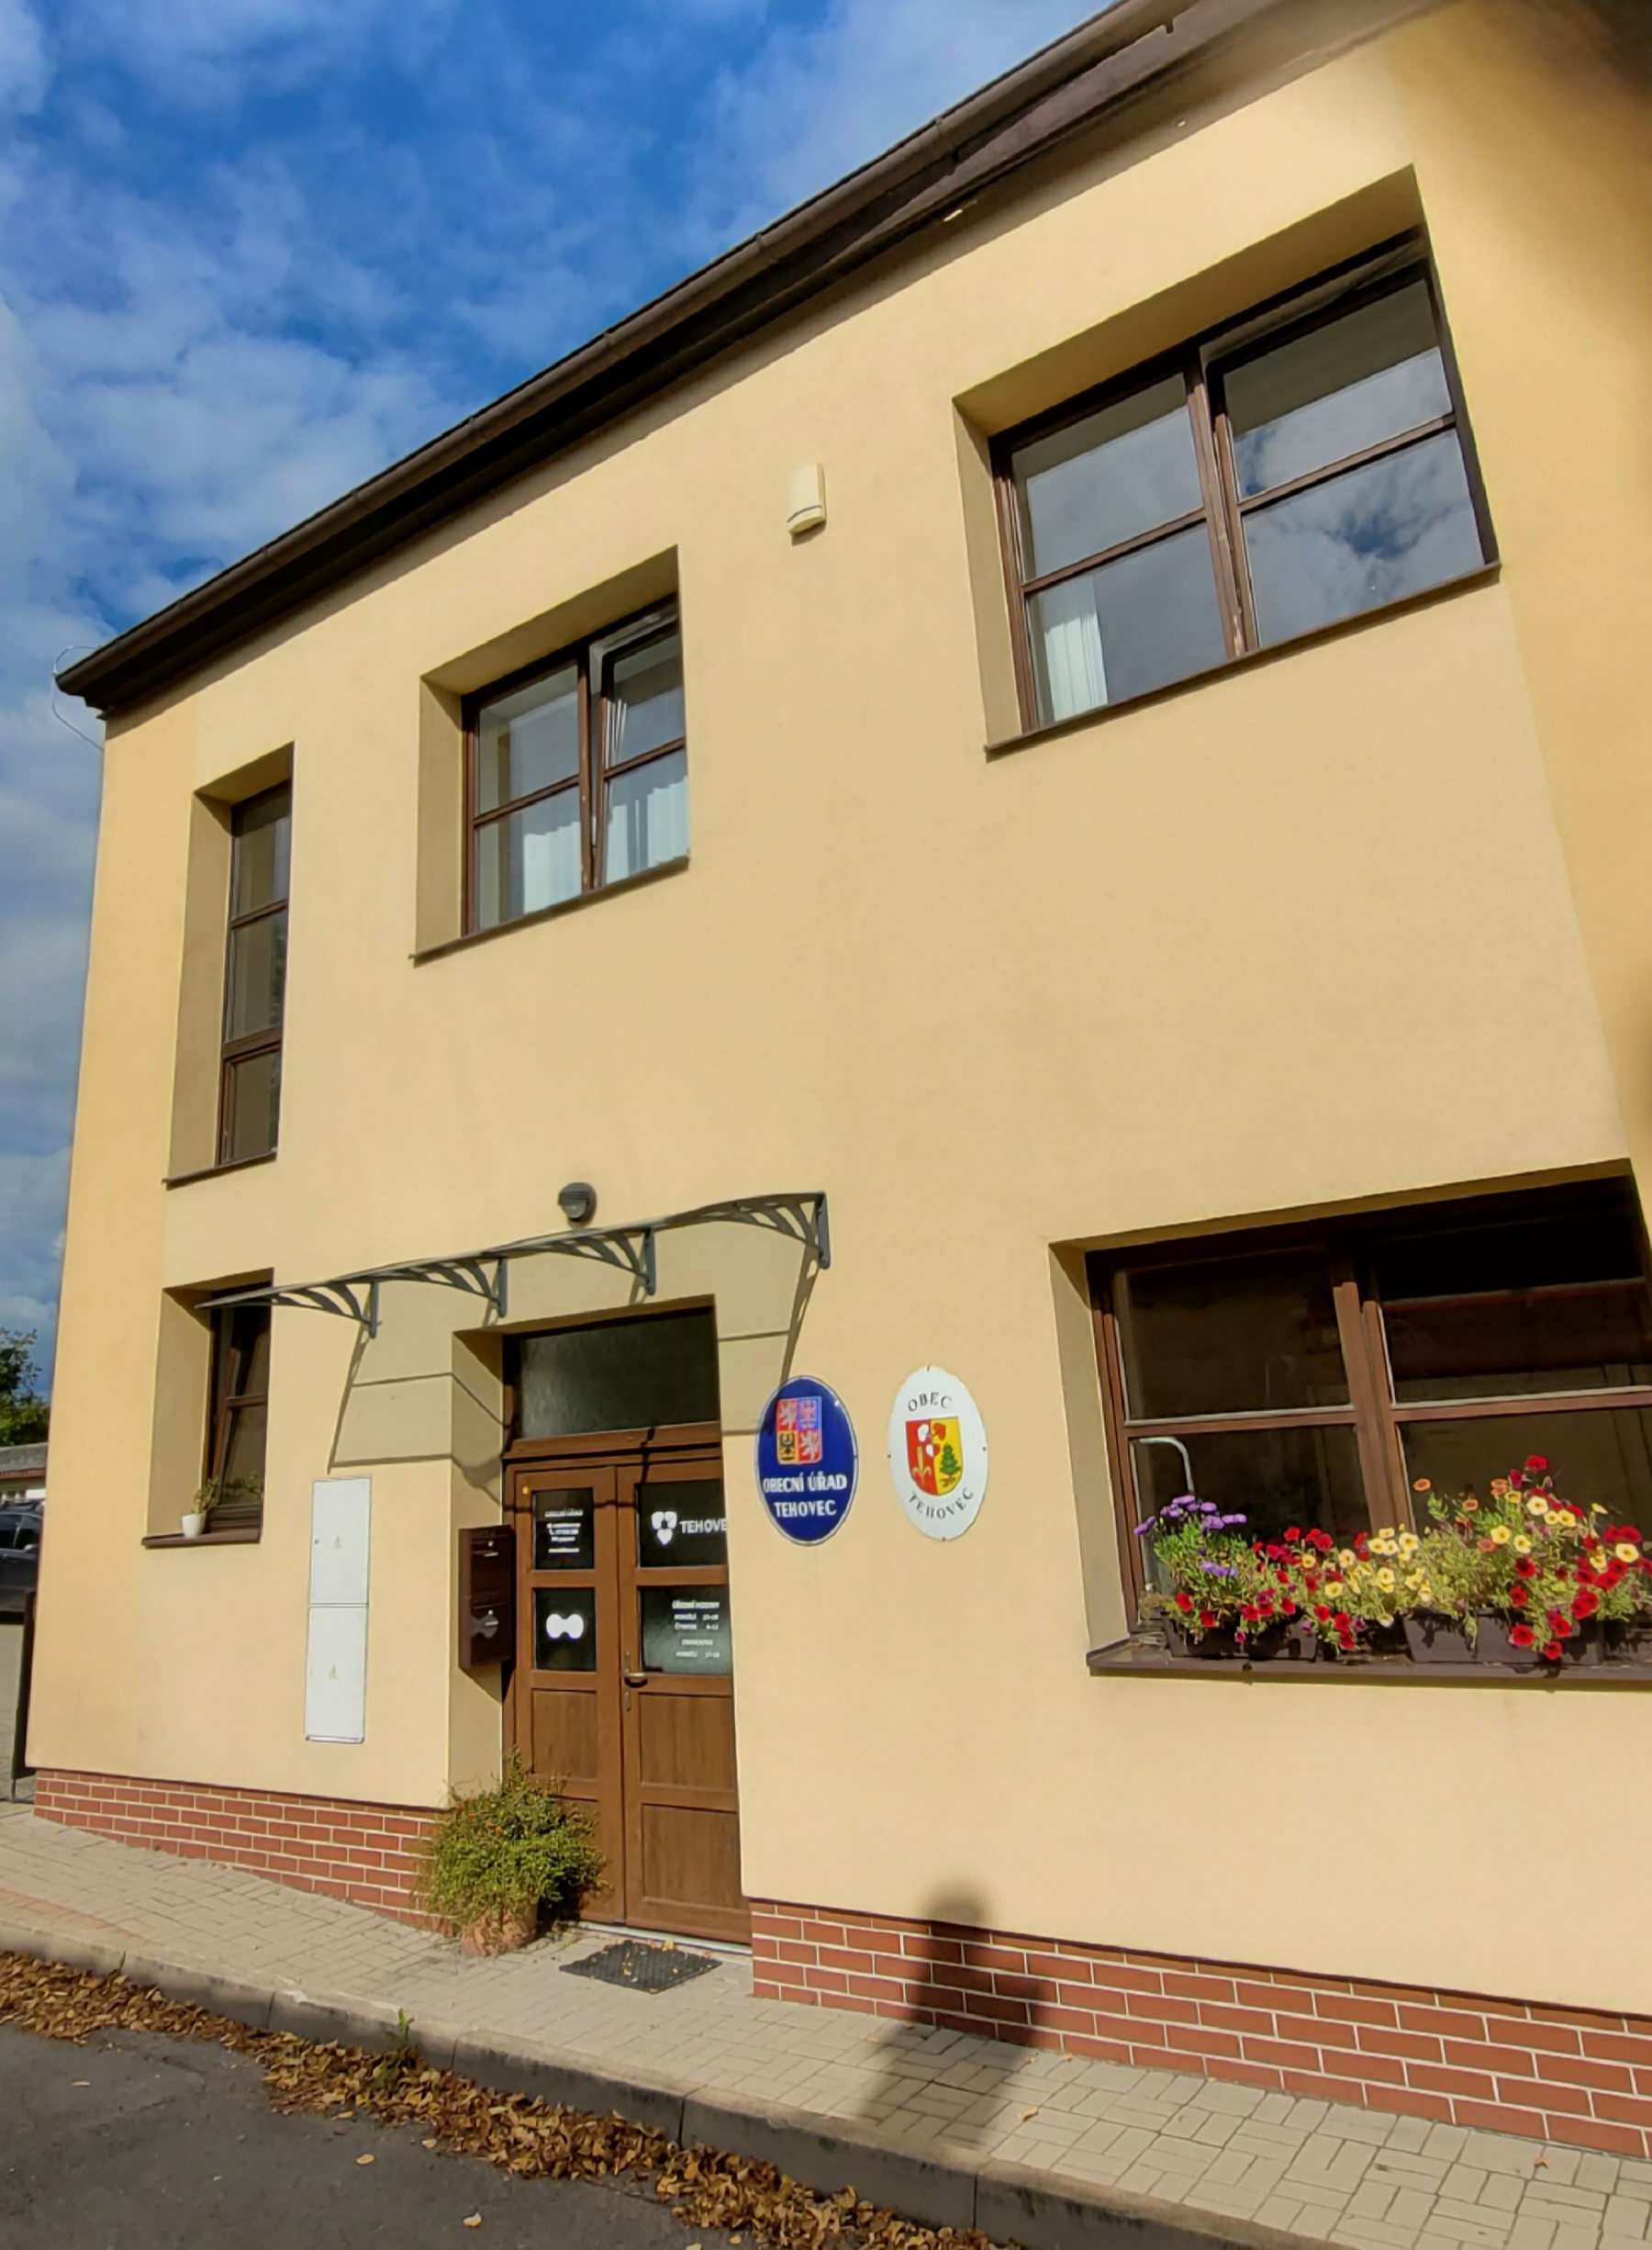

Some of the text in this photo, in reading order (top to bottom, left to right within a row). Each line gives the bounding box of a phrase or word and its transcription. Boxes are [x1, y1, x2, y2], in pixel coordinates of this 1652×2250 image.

[908, 1392, 952, 1411] OBEC
[764, 1471, 847, 1493] OBECNÍ ÚŘAD
[774, 1499, 837, 1517] TEHOVEC
[909, 1487, 973, 1519] TEHOVEC
